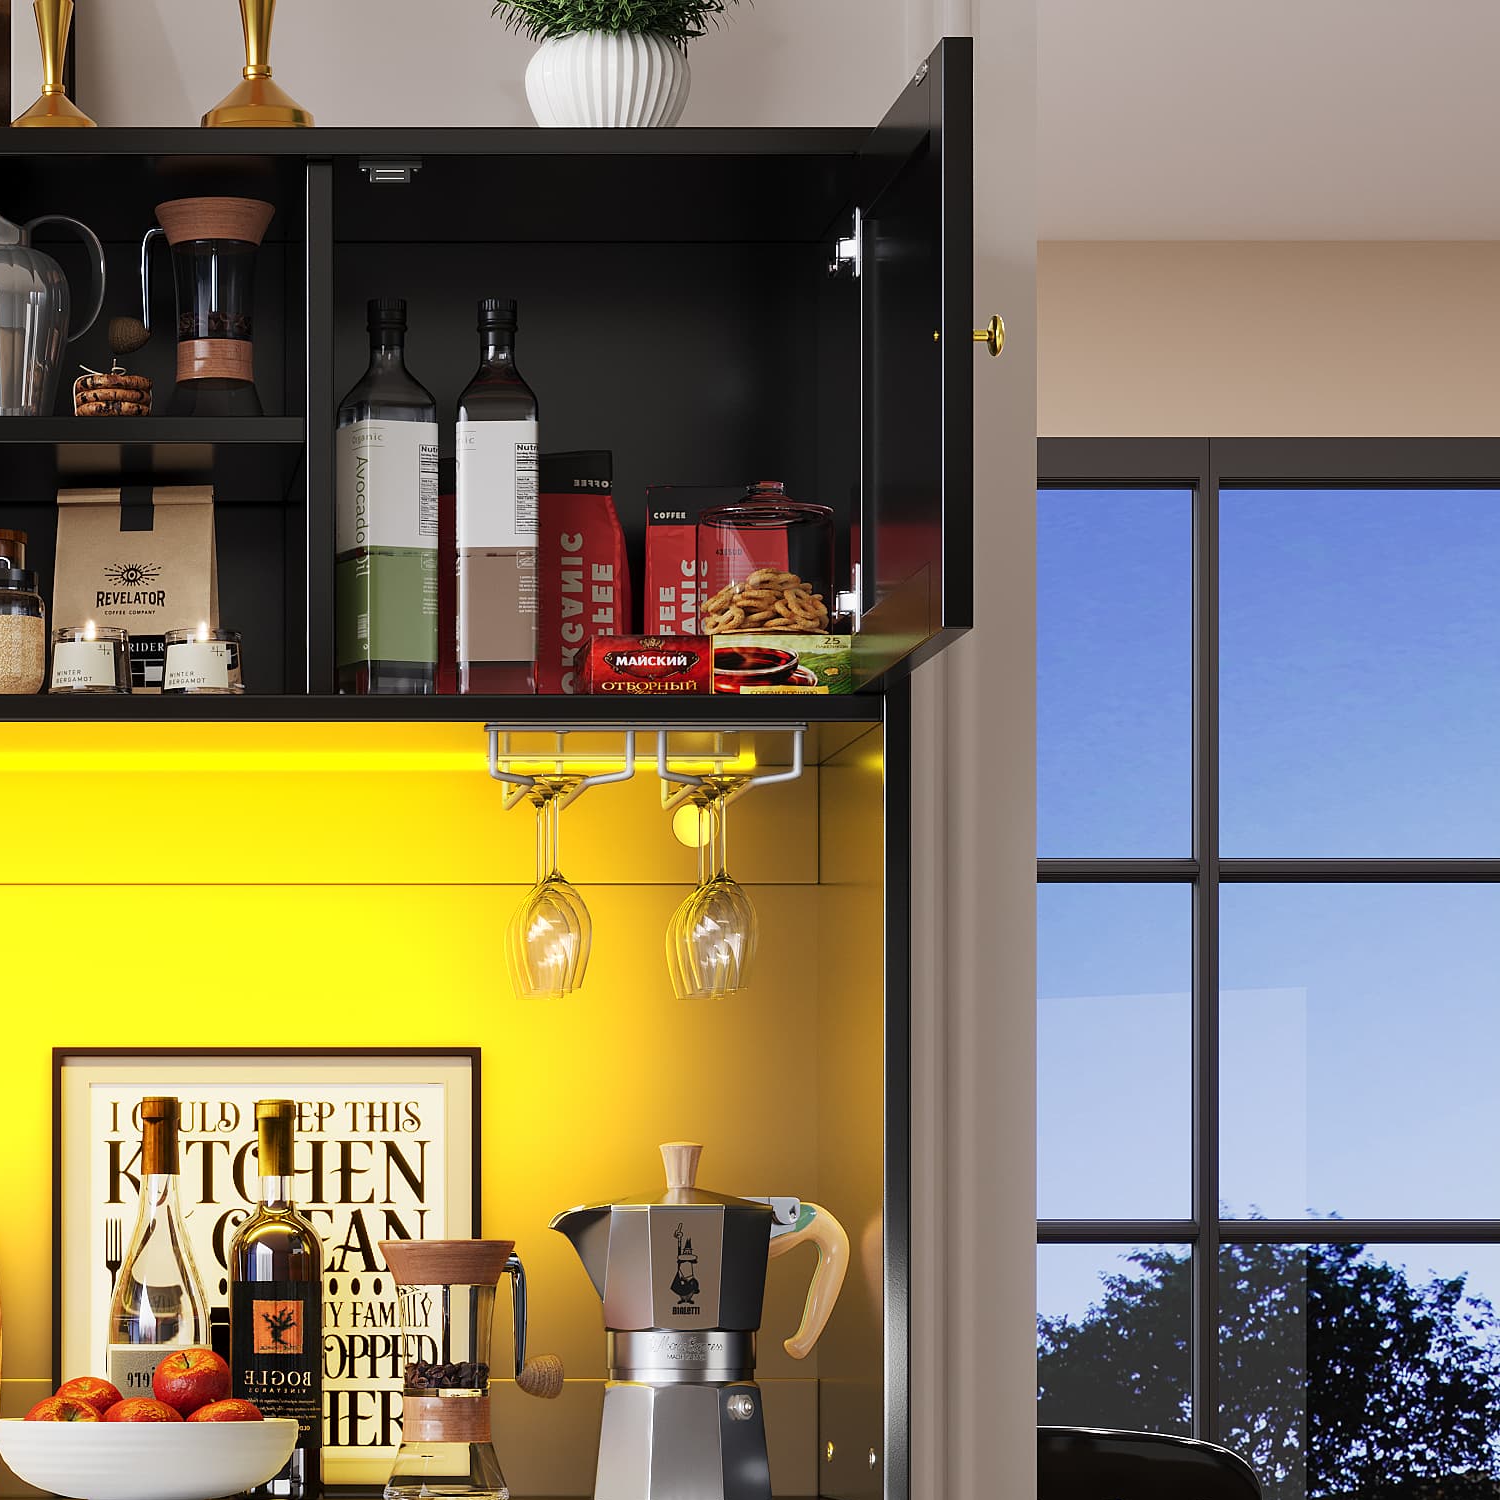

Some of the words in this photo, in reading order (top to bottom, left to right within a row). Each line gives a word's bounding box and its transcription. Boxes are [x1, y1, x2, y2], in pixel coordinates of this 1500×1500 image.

[355, 456, 369, 544] Avocado
[653, 511, 686, 520] COFFEE
[96, 590, 166, 609] REVELATOR
[824, 637, 841, 645] 25
[615, 655, 688, 666] МАЙСКИЙ
[56, 669, 82, 677] WINTER
[168, 670, 194, 679] WINTER
[55, 676, 93, 684] BERGAMOT
[168, 677, 206, 686] BERGAMOT
[601, 680, 697, 691] ОТБОРНЫЙ
[110, 1102, 120, 1133] I
[345, 1101, 422, 1133] THIS
[672, 1306, 701, 1315] BIALETTI
